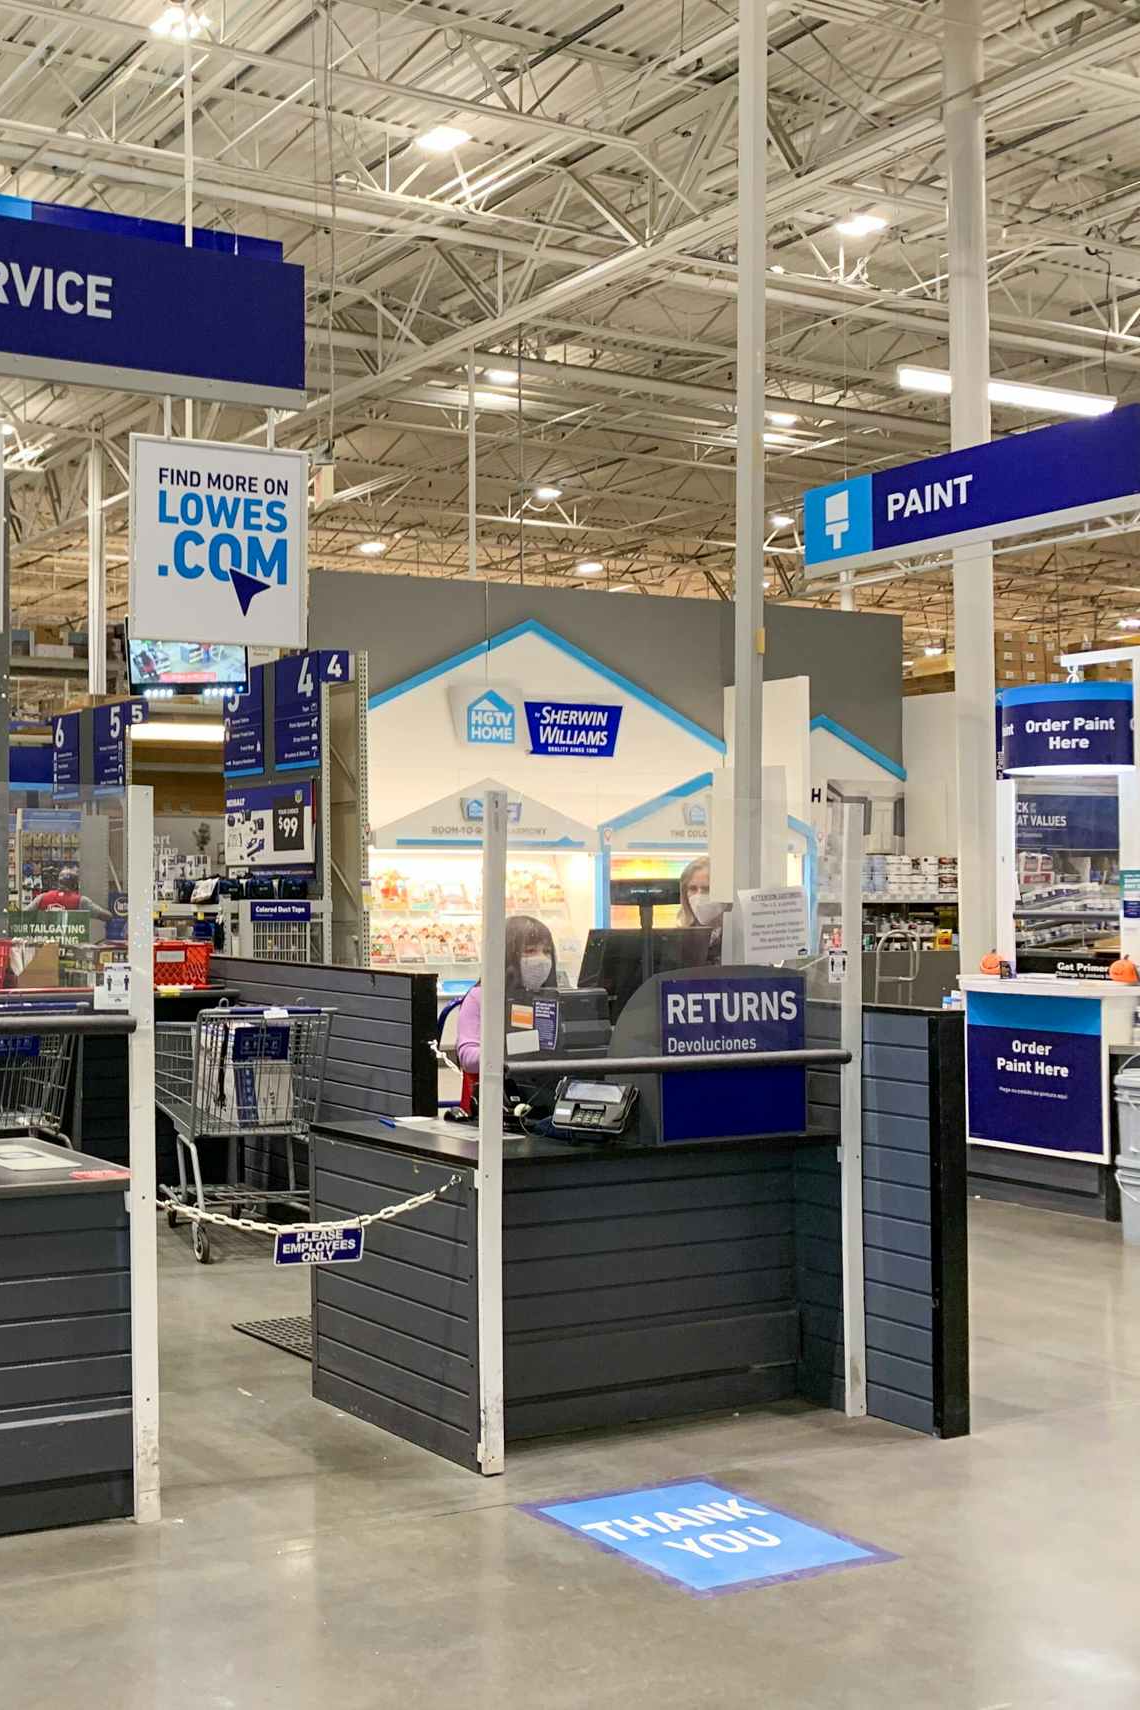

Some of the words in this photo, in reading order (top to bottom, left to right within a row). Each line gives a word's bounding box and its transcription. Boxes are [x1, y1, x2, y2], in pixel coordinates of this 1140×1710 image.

[159, 467, 201, 488] FIND
[207, 473, 258, 494] MORE
[264, 478, 288, 497] ON
[887, 473, 973, 522] PAINT
[158, 489, 288, 534] LOWES
[158, 530, 288, 586] .COM
[327, 654, 342, 677] 4
[297, 656, 314, 697] 4
[110, 705, 120, 738] 5
[131, 704, 143, 722] 5
[471, 710, 513, 726] HGTV
[540, 706, 608, 727] SHERWIN
[55, 717, 65, 748] 6
[471, 726, 513, 741] HOME
[1025, 718, 1070, 733] Order
[1073, 717, 1116, 731] Paint
[539, 726, 608, 747] WILLIAMS
[1048, 736, 1090, 750] Here
[1030, 815, 1067, 827] VALUES
[30, 924, 85, 934] TAILGATING
[1057, 962, 1074, 971] Get
[666, 990, 798, 1025] RETURNS
[667, 1035, 757, 1054] Devoluciones
[1012, 1039, 1052, 1056] Order
[997, 1056, 1032, 1073] Paint
[1034, 1061, 1069, 1077] Here
[282, 1239, 356, 1254] EMPLOYEES
[296, 1229, 344, 1243] PLEASE
[301, 1250, 336, 1262] ONLY
[579, 1498, 770, 1541] THANK
[662, 1525, 782, 1559] YOU
